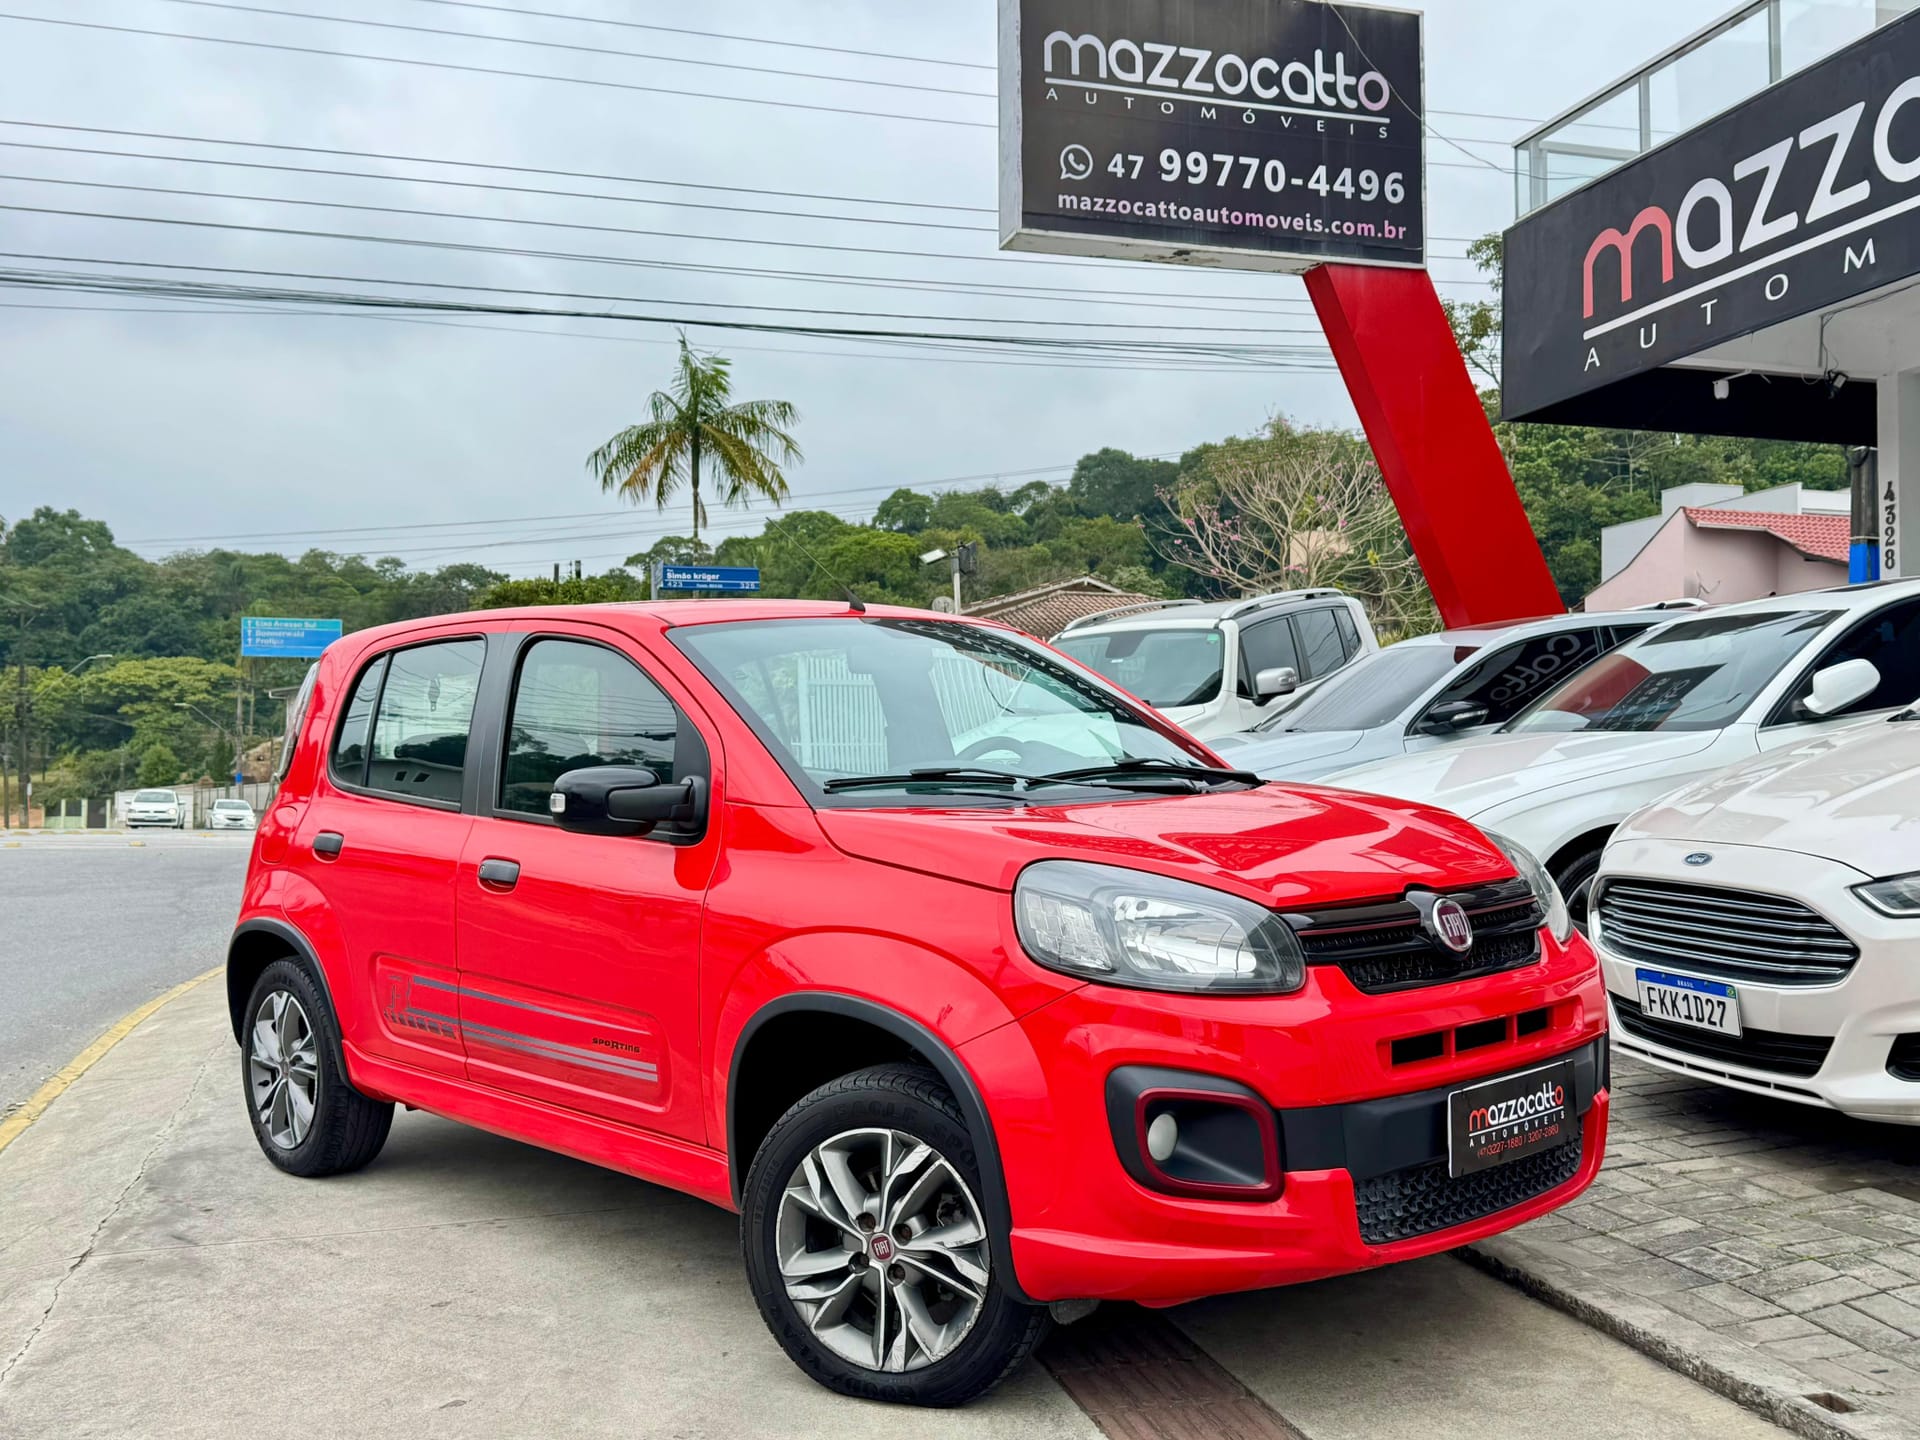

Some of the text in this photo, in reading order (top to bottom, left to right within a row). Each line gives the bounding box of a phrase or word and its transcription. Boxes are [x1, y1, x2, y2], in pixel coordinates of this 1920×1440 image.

[1043, 30, 1391, 111] mazzocatto
[1045, 88, 1390, 139] AUTOMÓVEIS
[1106, 148, 1406, 204] 47 99770-4496
[1057, 192, 1407, 240] mazzocattoautomoveis.com.br
[1883, 480, 1896, 570] 4328
[666, 572, 720, 582] Simão krüger
[1441, 911, 1467, 938] FIAT
[1676, 979, 1694, 989] BRASIL
[1646, 986, 1727, 1028] FKK1D27
[1469, 1081, 1565, 1132] mazzocatto
[1469, 1110, 1565, 1148] AUTOMÓVEIS
[874, 1240, 890, 1256] FIAT
